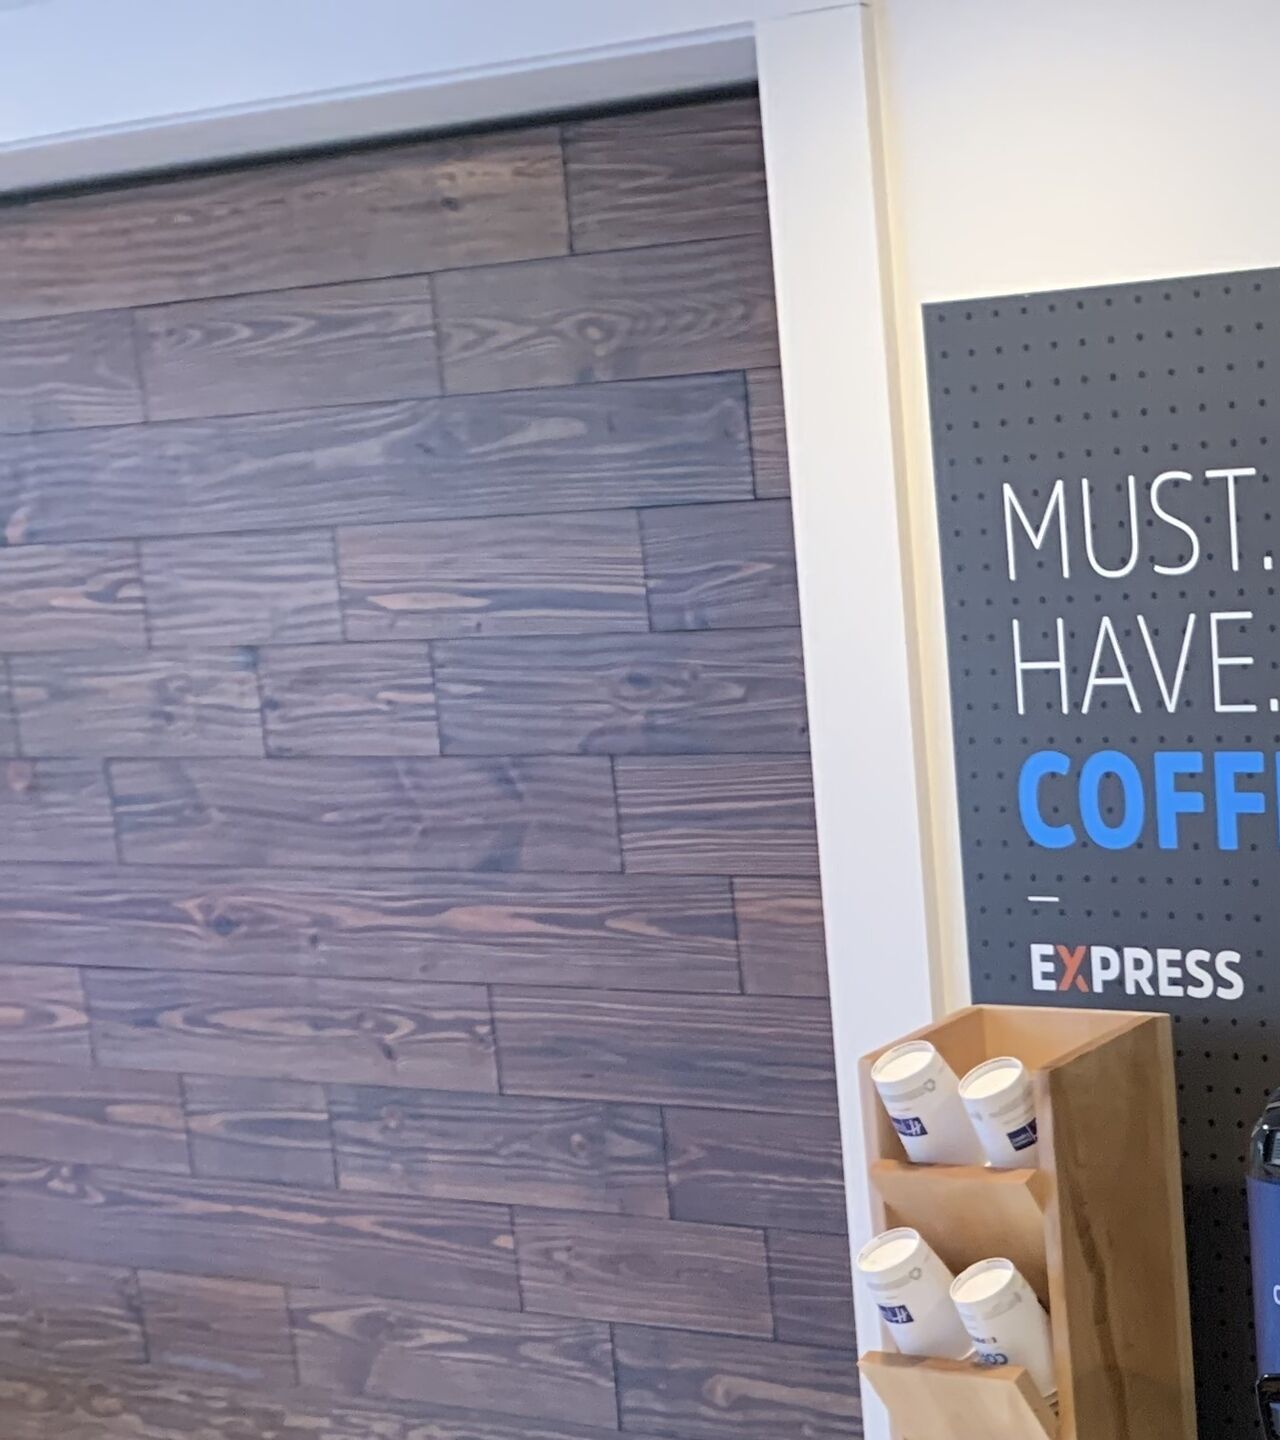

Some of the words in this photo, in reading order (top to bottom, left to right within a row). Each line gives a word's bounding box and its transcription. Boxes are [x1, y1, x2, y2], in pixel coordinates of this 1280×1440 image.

[1002, 467, 1274, 581] MUST.
[1010, 611, 1279, 715] HAVE.
[1029, 943, 1245, 1001] EXPRESS
